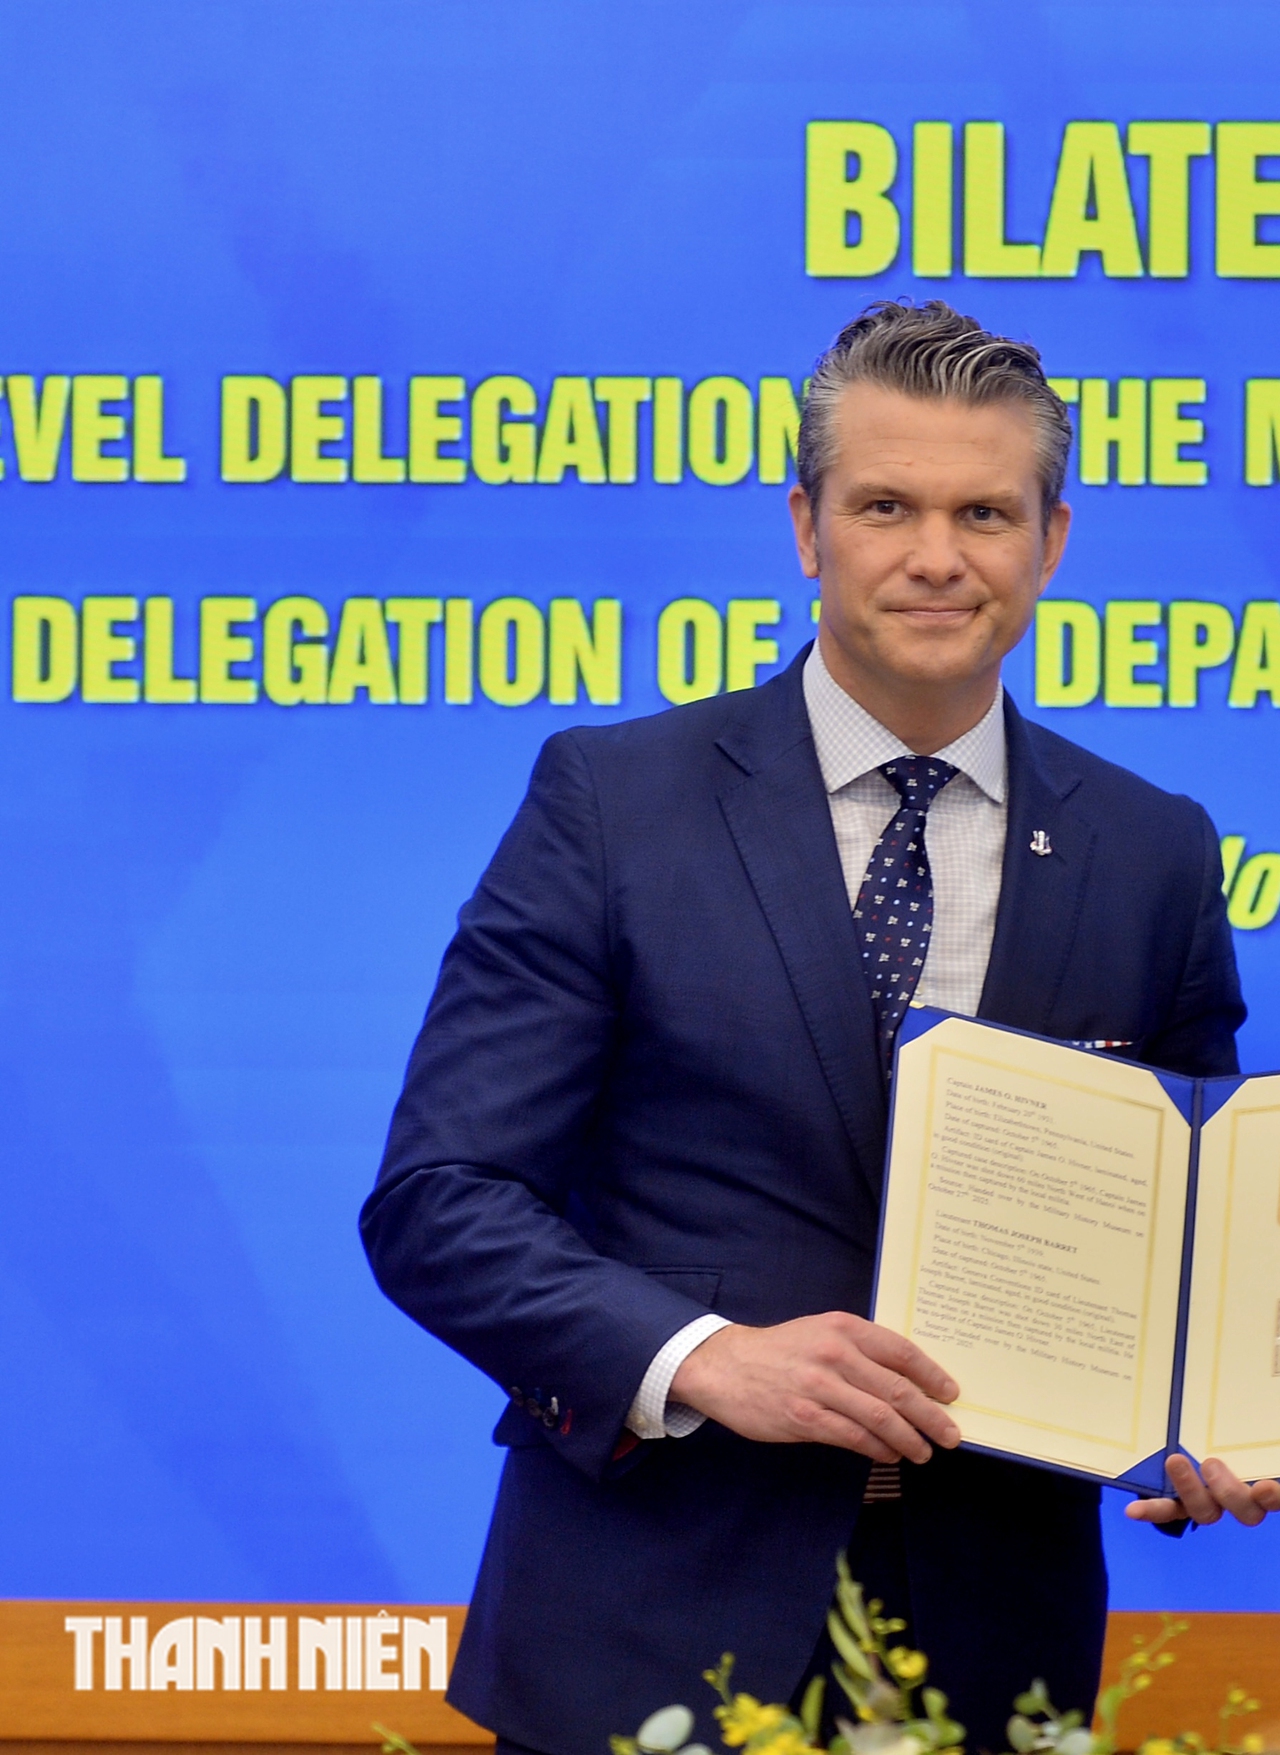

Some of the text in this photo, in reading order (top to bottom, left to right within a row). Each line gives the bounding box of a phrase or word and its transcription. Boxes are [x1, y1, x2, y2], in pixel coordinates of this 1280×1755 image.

[0, 375, 187, 483] VEL
[221, 376, 806, 484] DELEGATION
[1048, 378, 1208, 486] HE
[12, 597, 622, 705] DELEGATION
[657, 599, 780, 705] OF
[973, 1220, 1008, 1234] THOMAS
